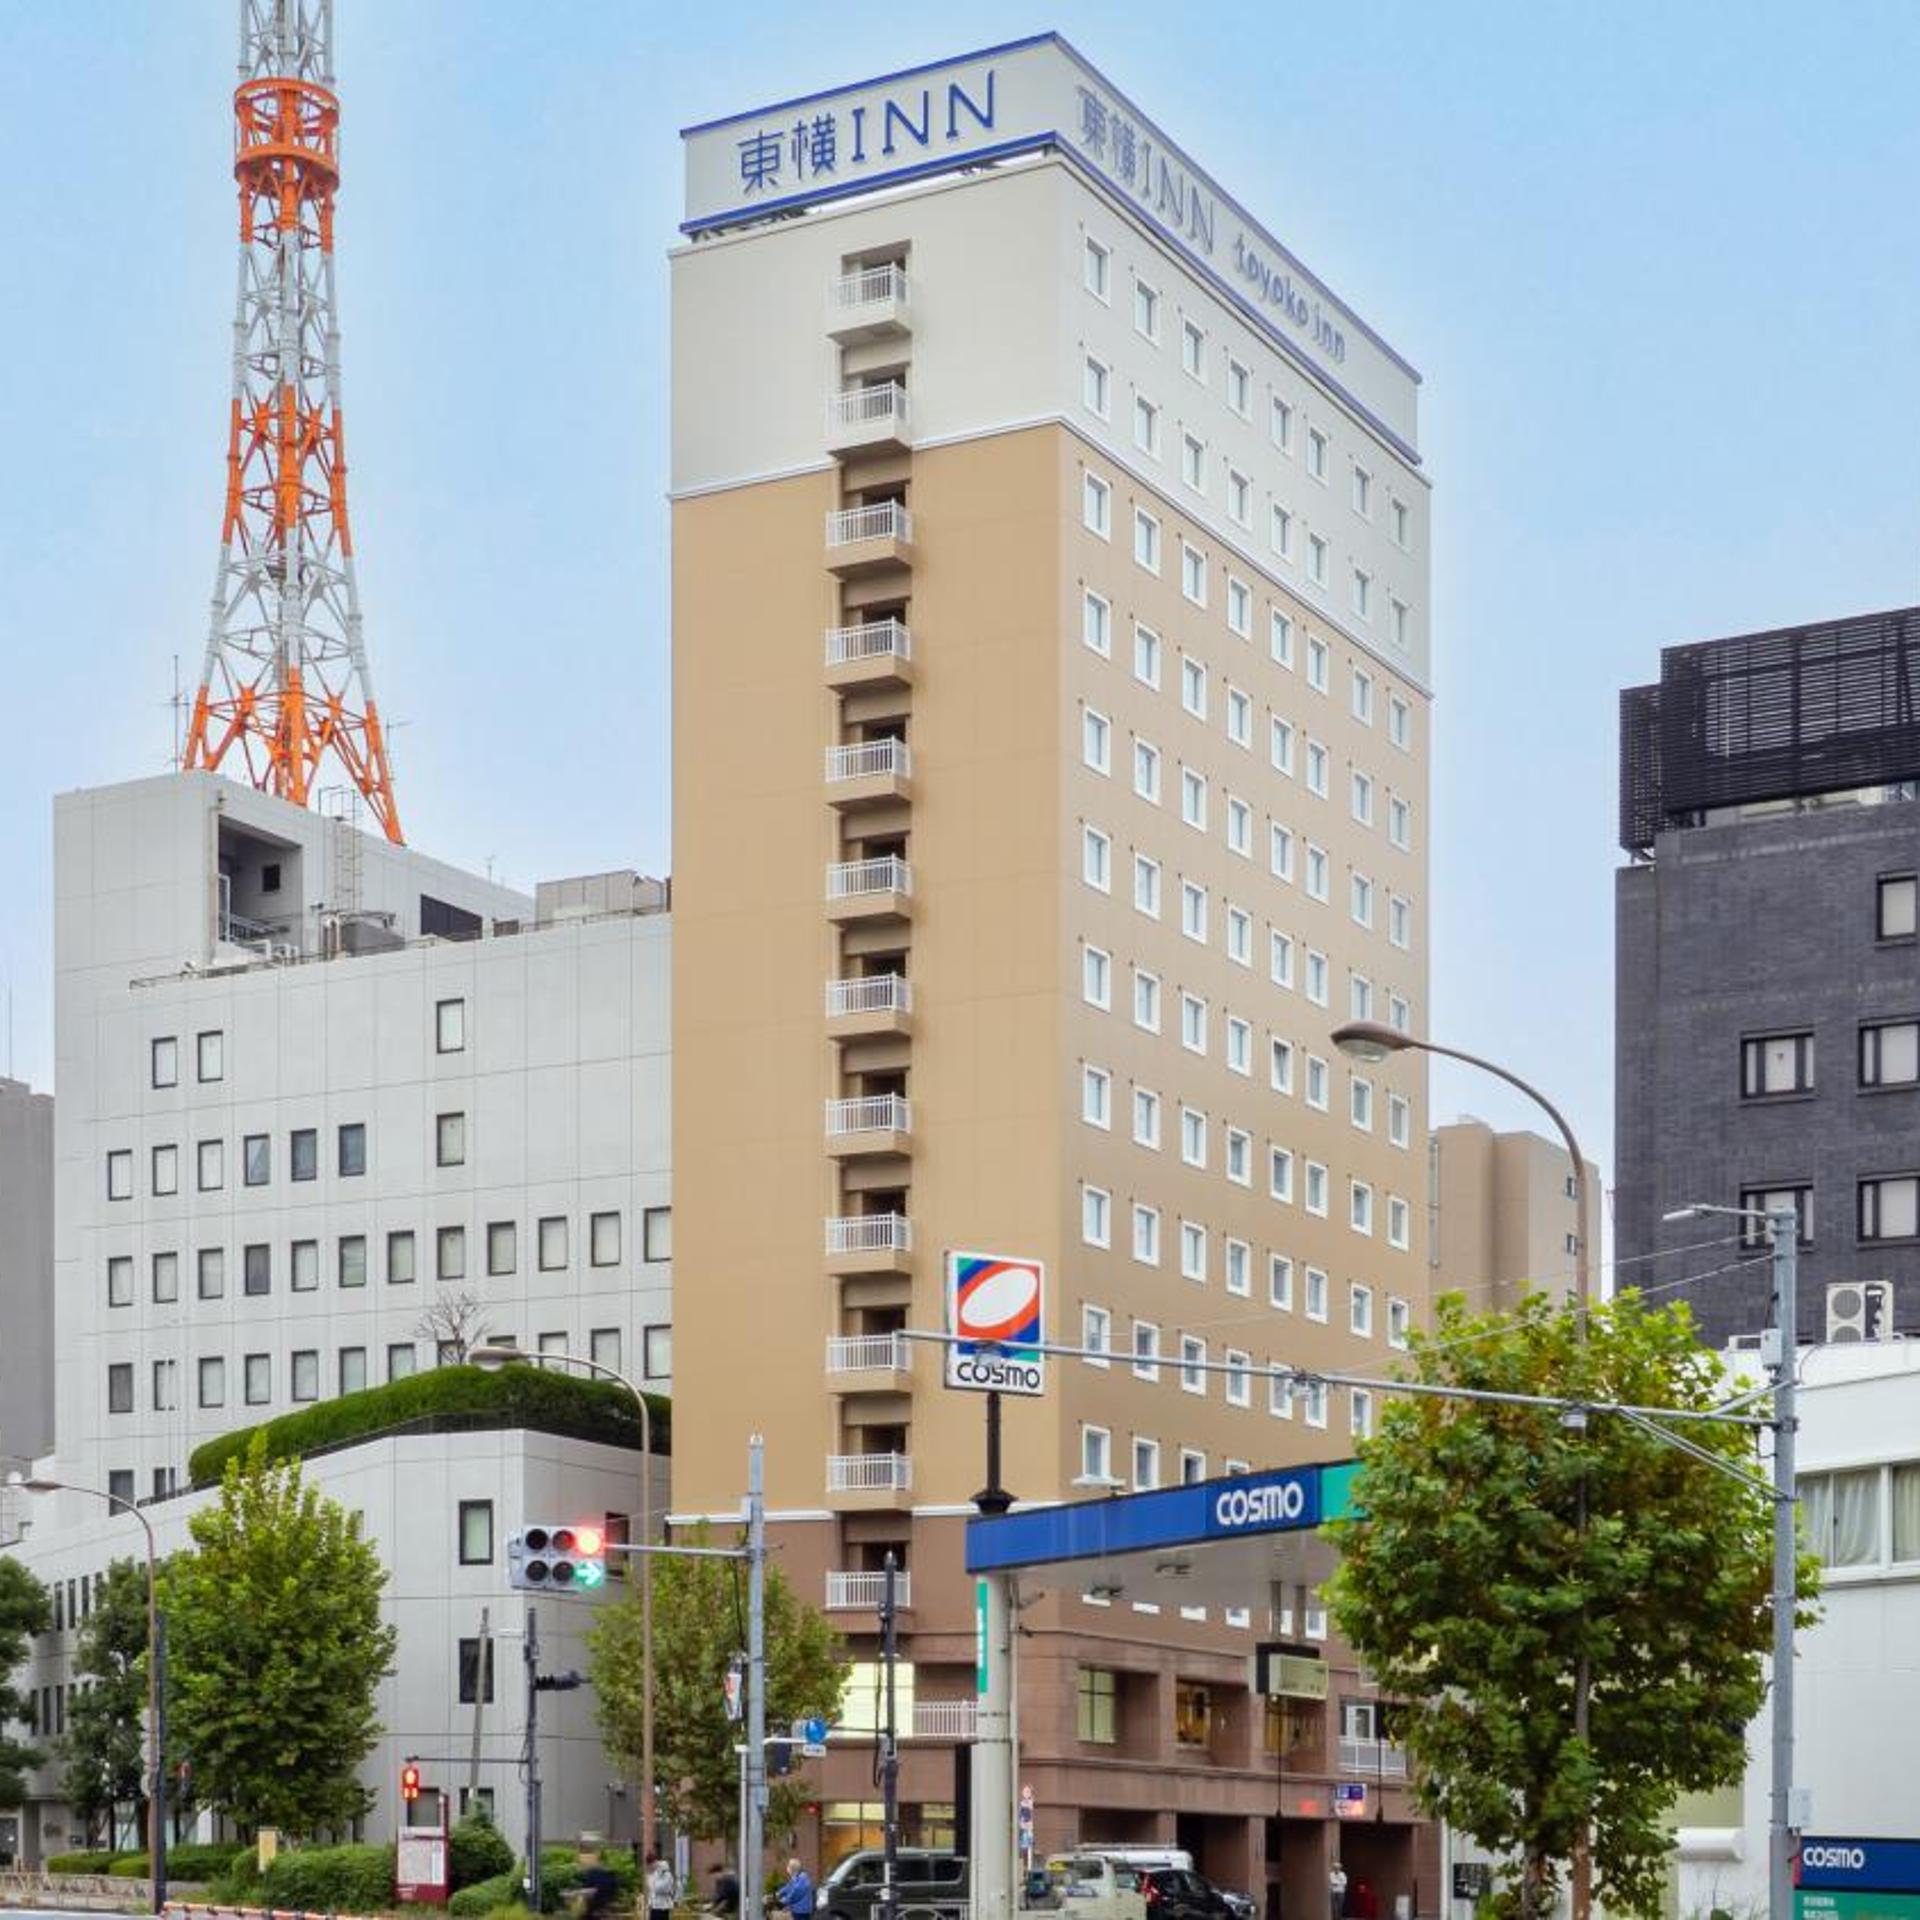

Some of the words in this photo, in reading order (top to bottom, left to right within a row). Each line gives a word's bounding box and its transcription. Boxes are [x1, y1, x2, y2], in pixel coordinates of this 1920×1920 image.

[737, 69, 995, 195] 東横INN
[1233, 233, 1309, 328] toyoko
[1312, 303, 1345, 364] inn
[957, 1362, 1040, 1389] COSMO
[1216, 1481, 1304, 1525] COSMO
[1803, 1846, 1865, 1869] COSMO
